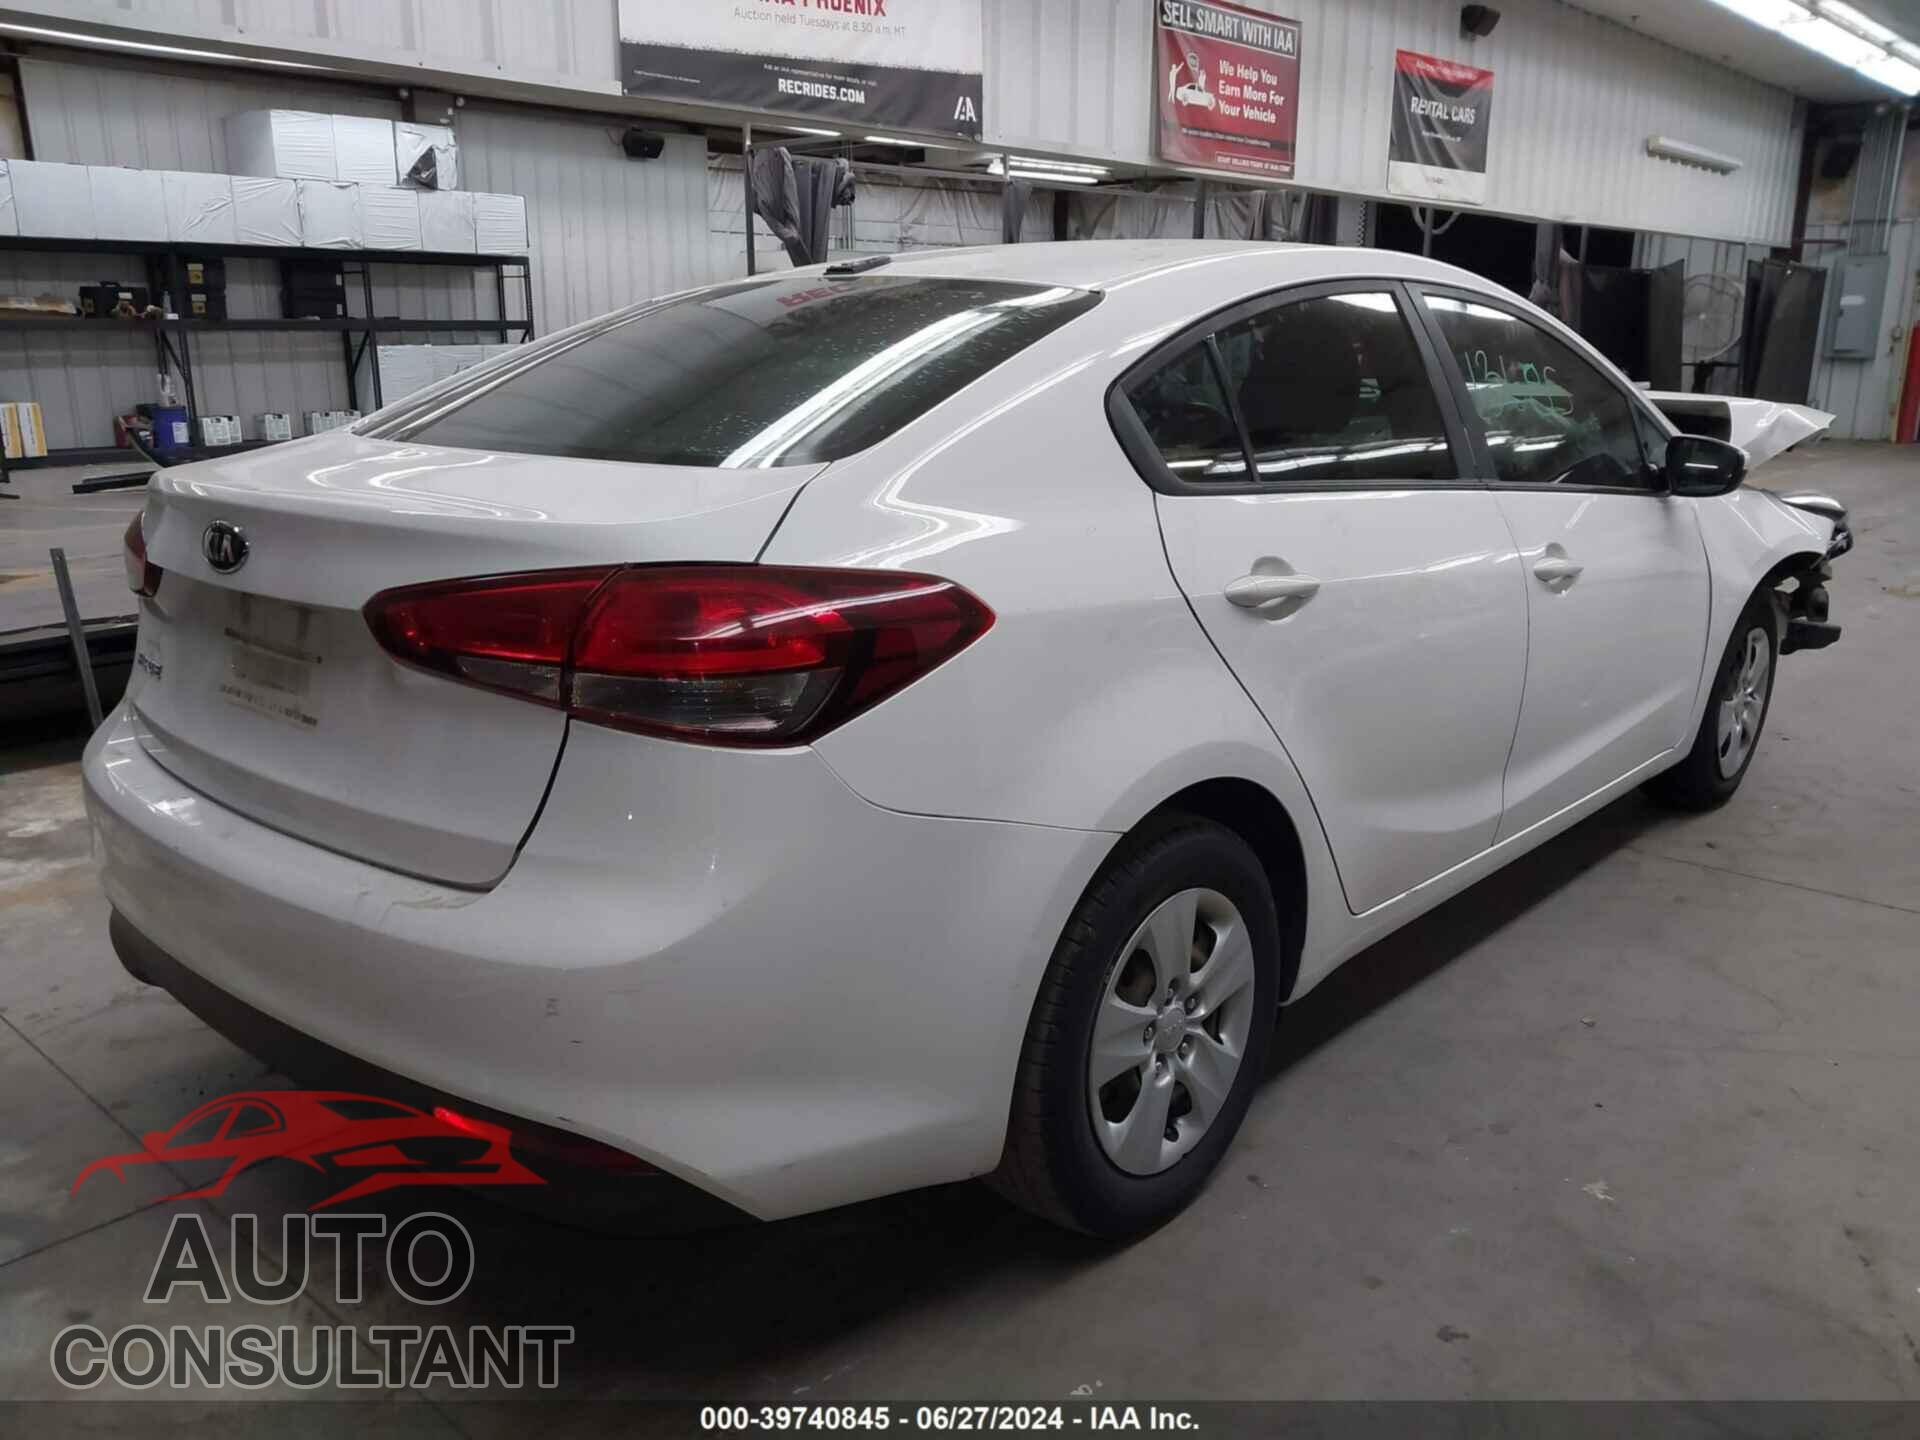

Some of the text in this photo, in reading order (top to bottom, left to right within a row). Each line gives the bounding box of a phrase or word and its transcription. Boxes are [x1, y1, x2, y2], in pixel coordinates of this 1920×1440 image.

[733, 7, 772, 21] Auction
[774, 14, 796, 25] held
[799, 15, 841, 31] Tuesdays
[1163, 1, 1293, 53] SELL SMART WITH IAA
[1219, 59, 1234, 76] We
[1237, 63, 1258, 84] Help
[1260, 68, 1278, 86] You
[778, 78, 865, 104] RECRIDES.COM
[1219, 80, 1285, 106] Earn More For
[1218, 99, 1277, 124] Your Vehicle
[1451, 105, 1476, 125] CARS
